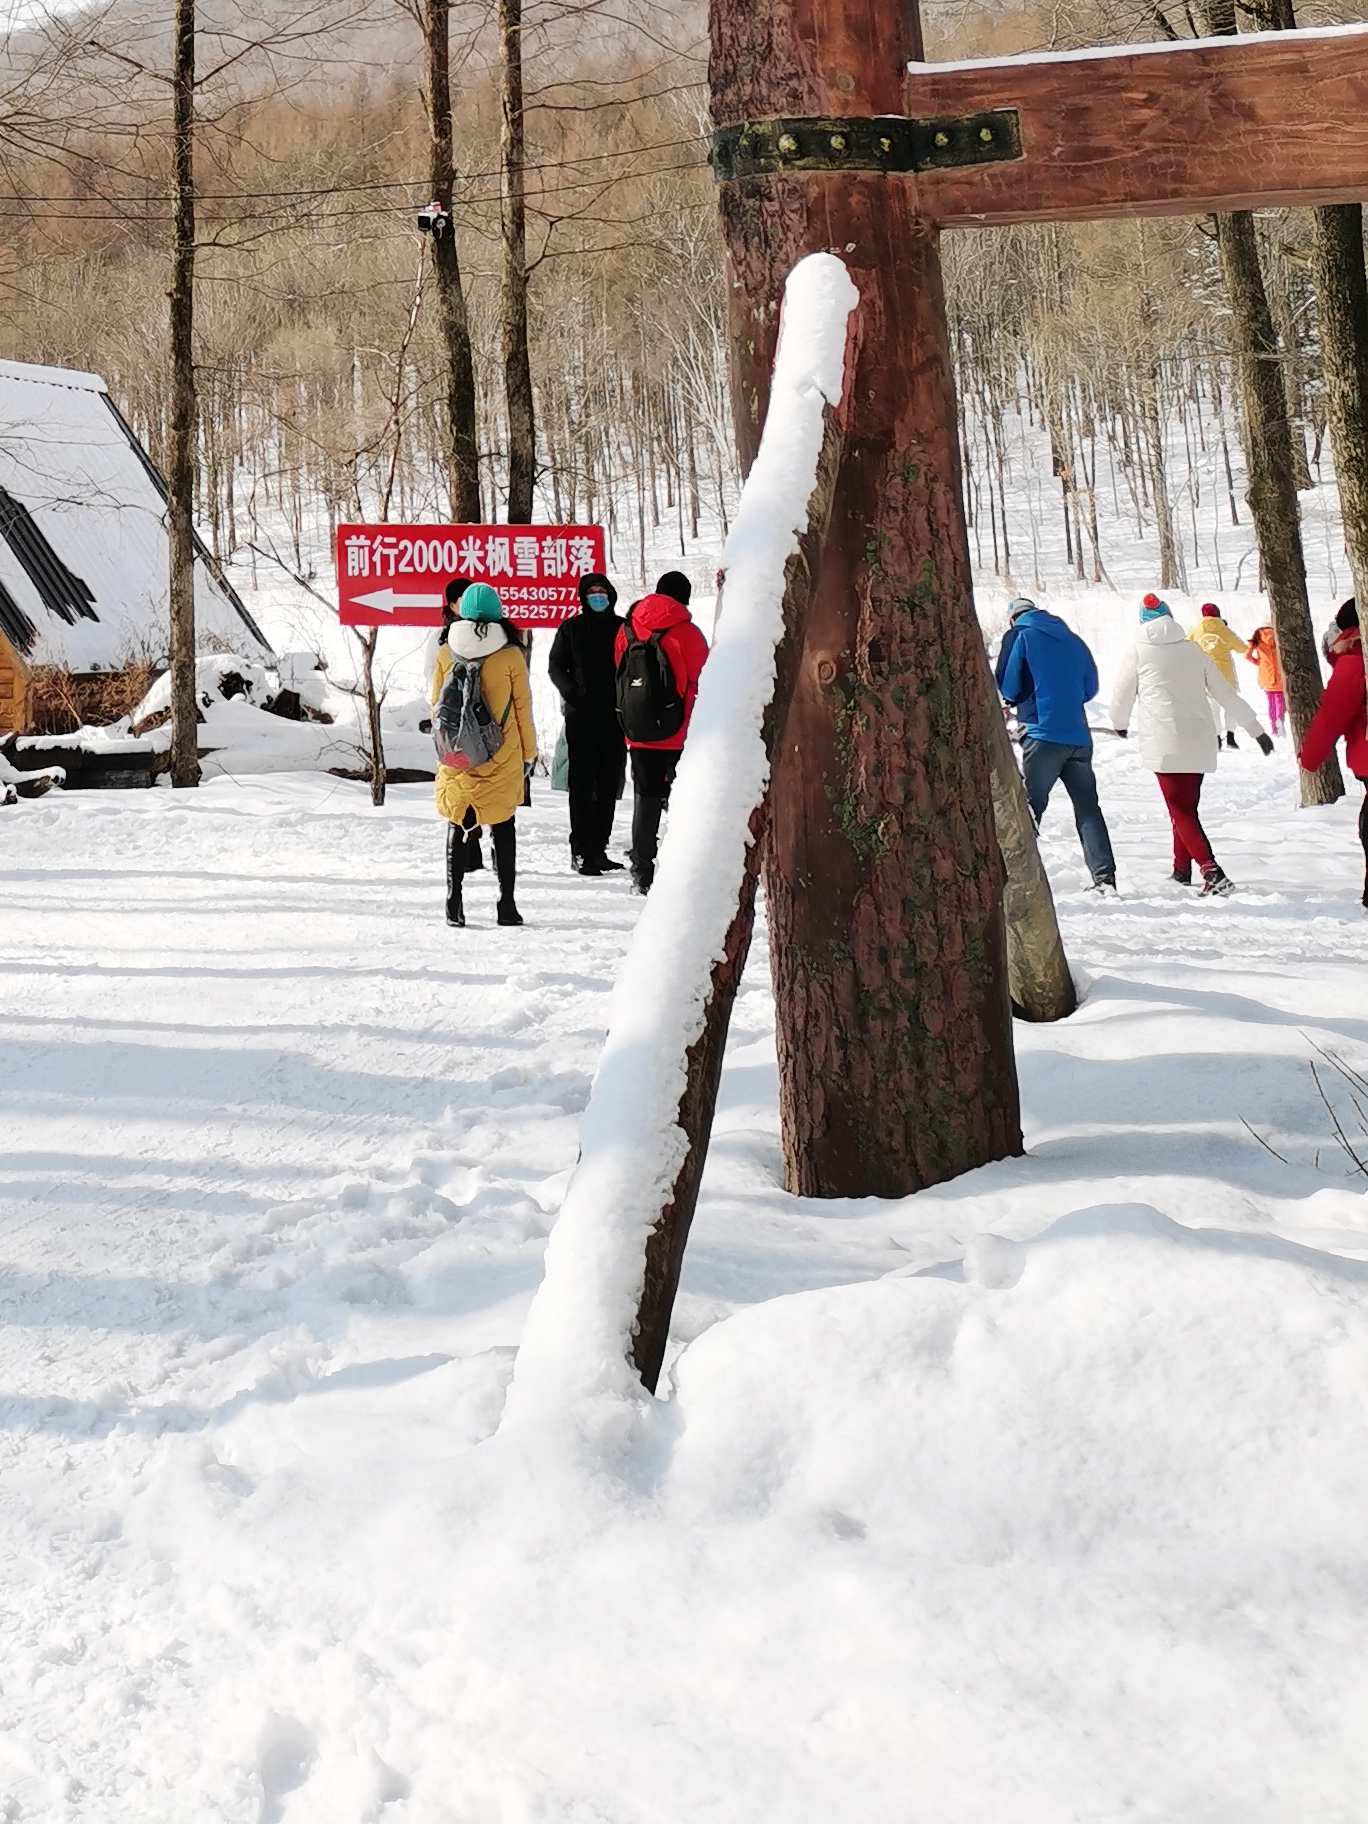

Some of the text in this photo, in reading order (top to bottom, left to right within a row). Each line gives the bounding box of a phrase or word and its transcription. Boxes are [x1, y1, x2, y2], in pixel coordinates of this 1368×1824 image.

[344, 534, 596, 579] 前行2000米枫雪部落
